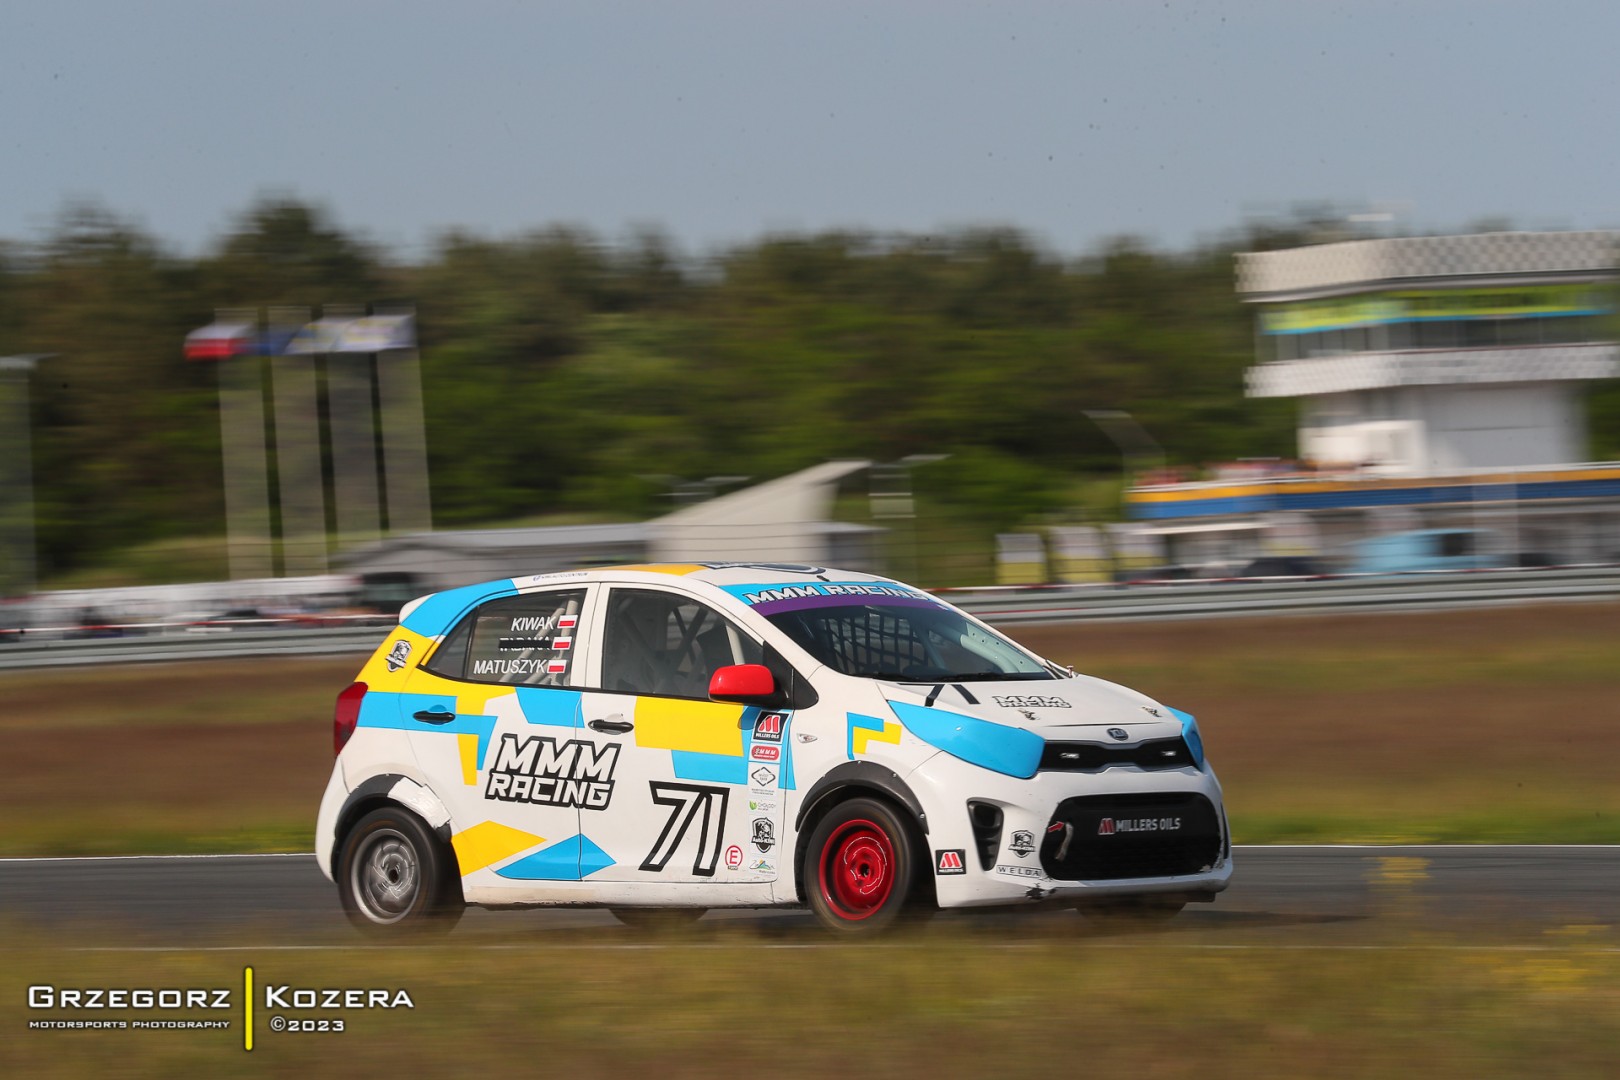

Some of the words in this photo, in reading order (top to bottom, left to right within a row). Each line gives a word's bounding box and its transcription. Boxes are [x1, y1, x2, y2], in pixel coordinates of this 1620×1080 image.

[743, 585, 821, 605] MMM
[821, 584, 930, 600] RACING
[511, 617, 556, 631] KIWAK
[473, 660, 547, 674] MATUSZYK
[495, 733, 622, 782] MMM
[485, 769, 615, 811] RACING
[638, 780, 730, 877] 71
[1115, 819, 1158, 832] MILLERS
[1159, 818, 1181, 830] OILS
